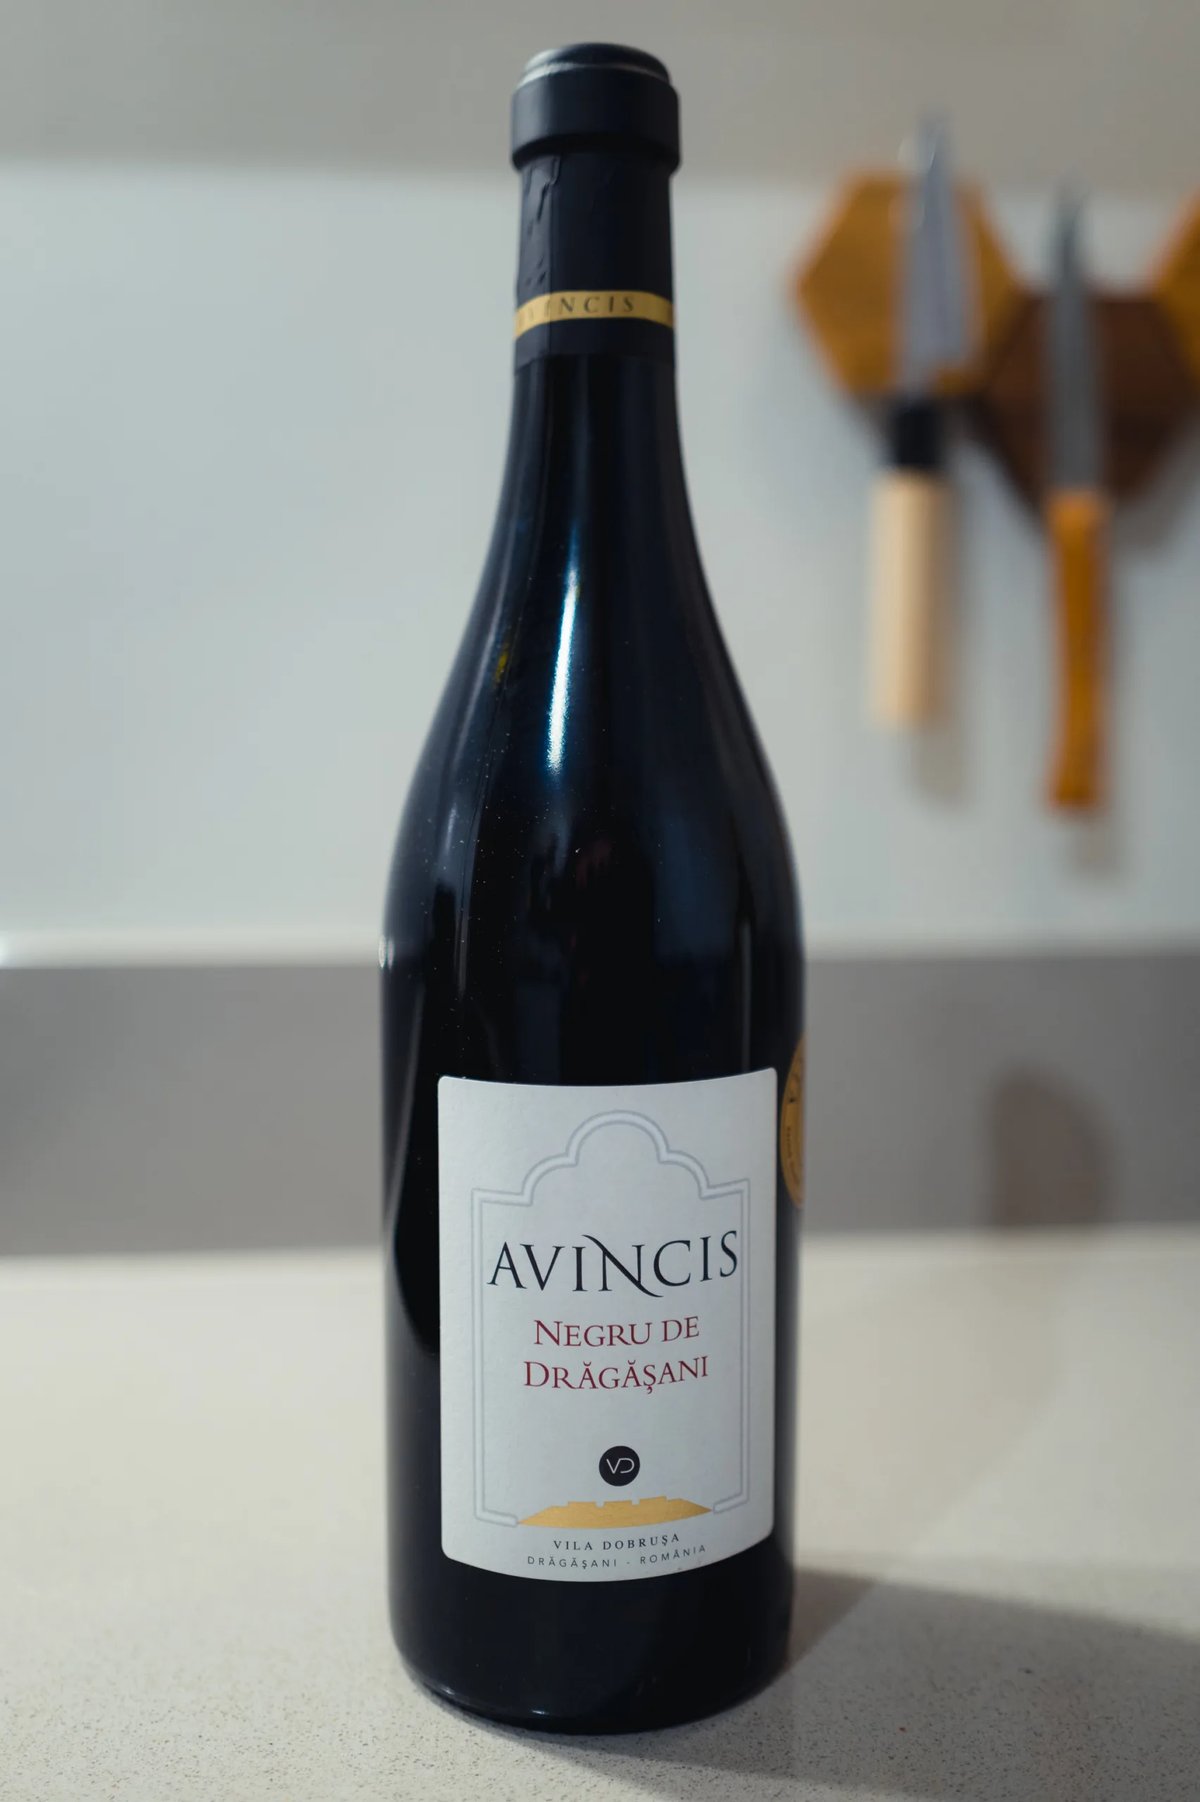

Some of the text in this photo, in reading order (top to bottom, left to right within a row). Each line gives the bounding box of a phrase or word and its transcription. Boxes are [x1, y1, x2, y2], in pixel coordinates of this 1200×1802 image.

[487, 1230, 738, 1298] AVINCIS
[533, 1316, 700, 1347] NEGRU DE
[606, 1457, 635, 1474] VD
[553, 1540, 593, 1551] VILA
[639, 1544, 706, 1564] ROMÂNIA
